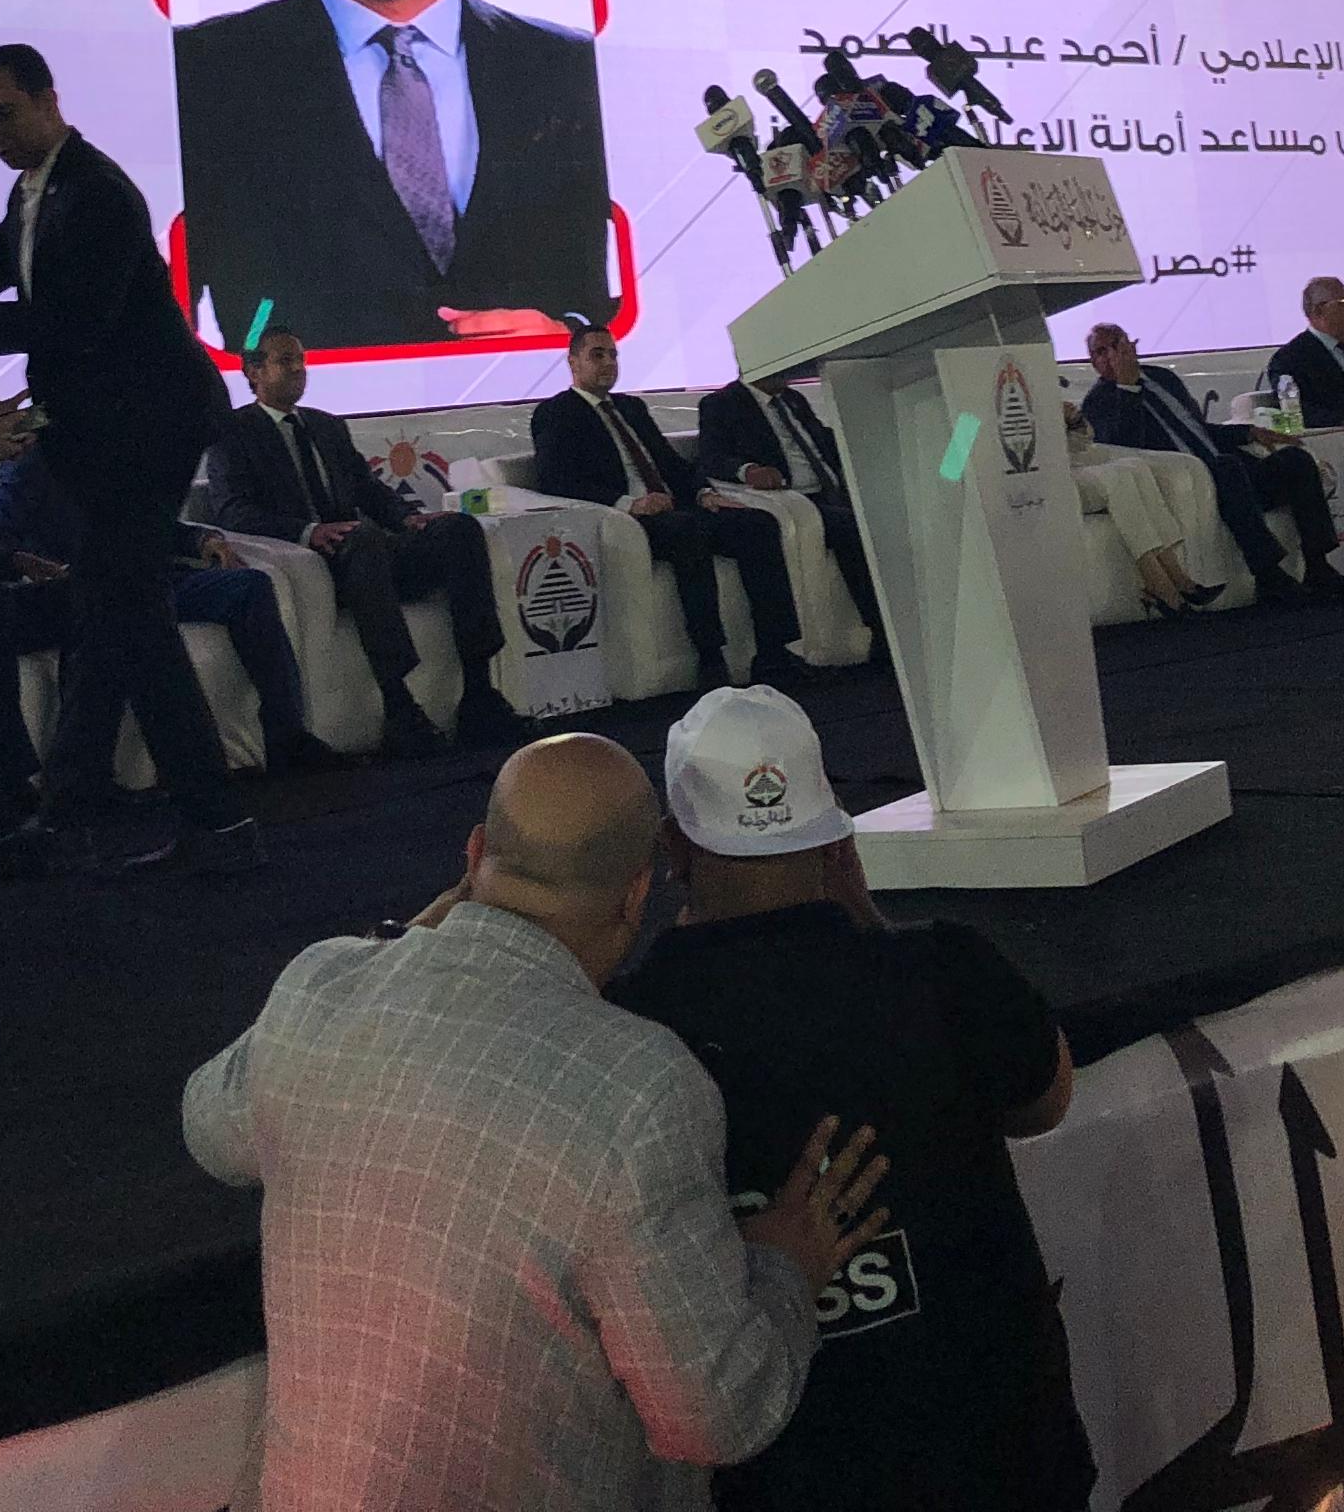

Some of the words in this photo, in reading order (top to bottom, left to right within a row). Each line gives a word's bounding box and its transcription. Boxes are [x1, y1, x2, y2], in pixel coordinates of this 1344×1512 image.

[965, 34, 1047, 70] عبد
[1060, 23, 1160, 67] أحمد
[1201, 39, 1344, 84] الإعلامي
[1090, 110, 1186, 156] أمانة
[1200, 121, 1327, 156] مساعد
[1150, 244, 1258, 285] #مصر
